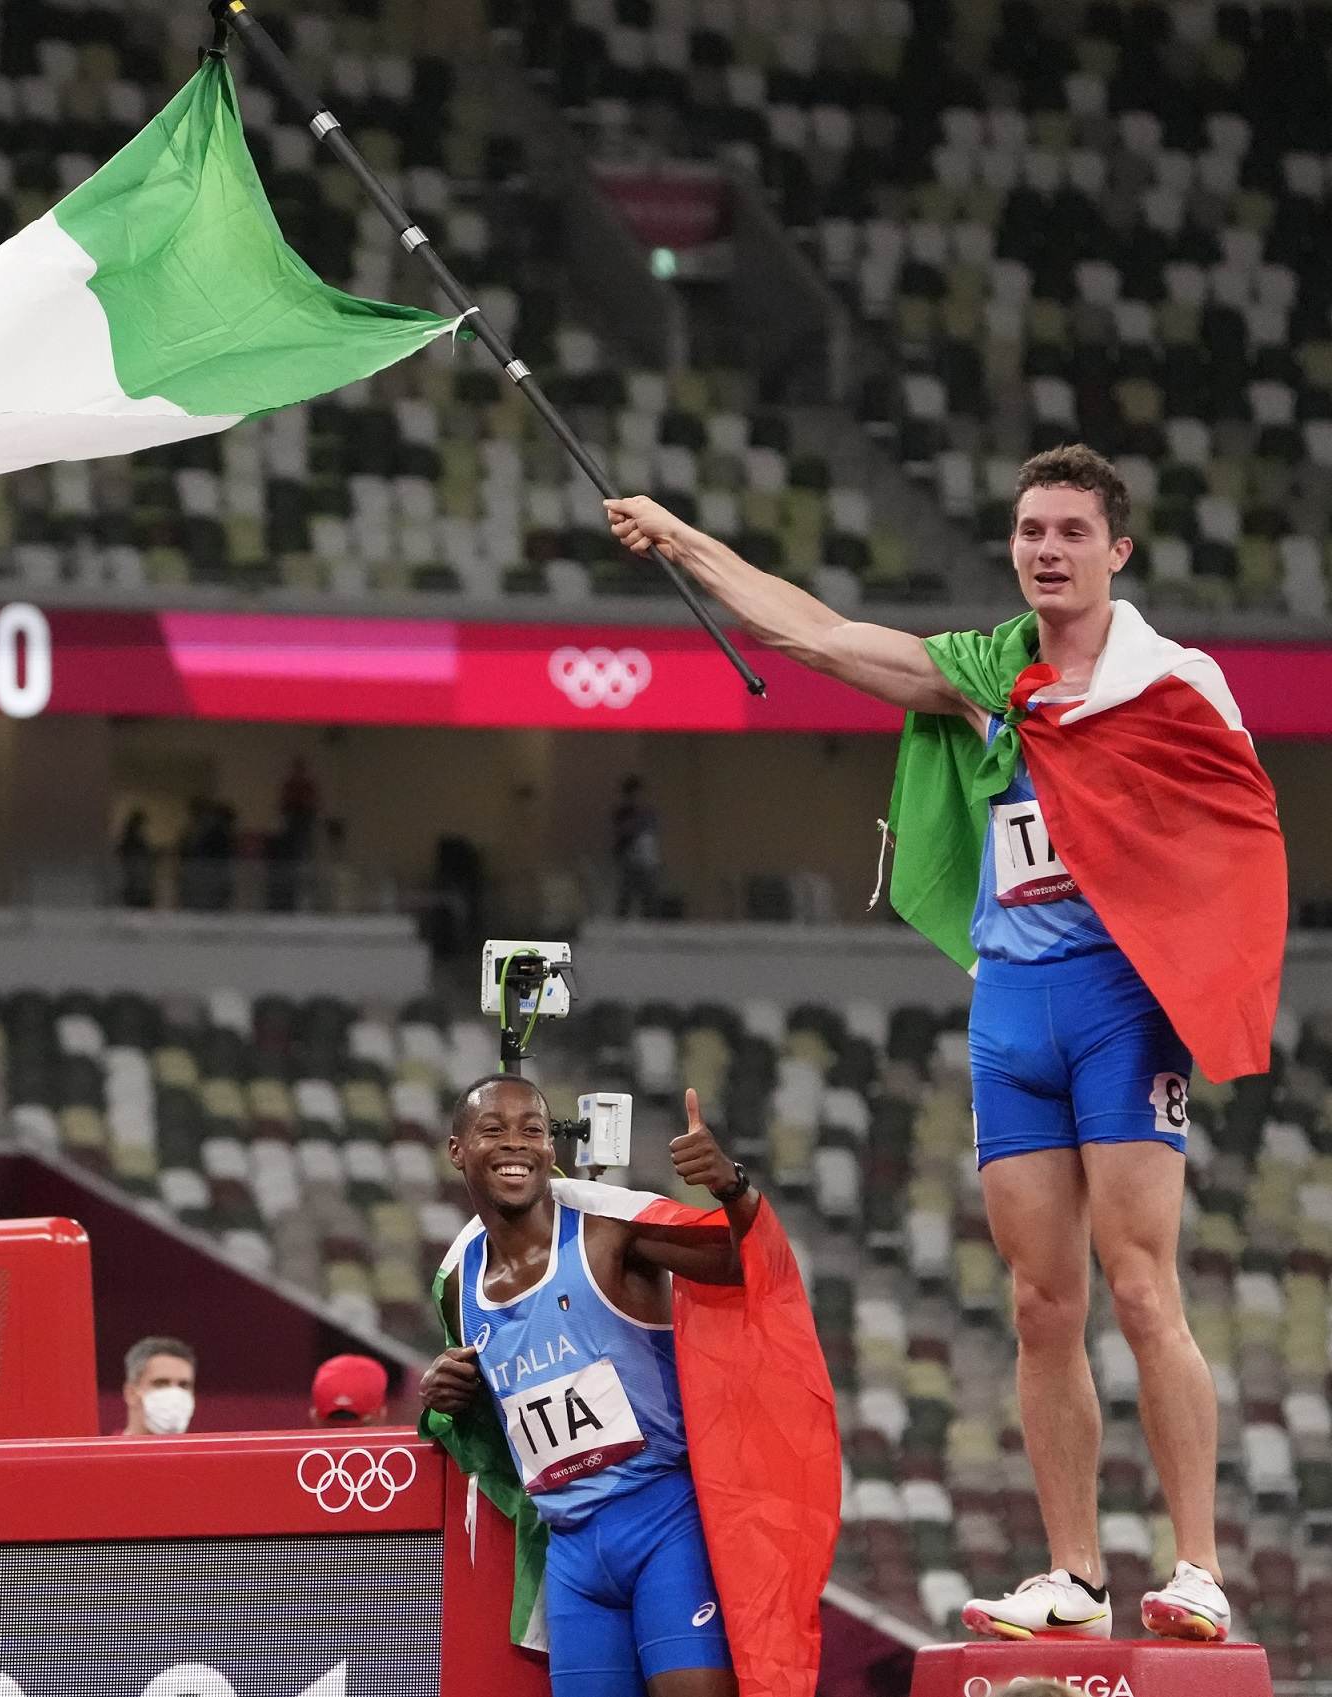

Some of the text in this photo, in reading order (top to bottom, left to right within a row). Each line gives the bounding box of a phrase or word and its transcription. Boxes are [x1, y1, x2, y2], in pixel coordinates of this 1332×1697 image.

[1166, 1078, 1185, 1127] 8
[488, 1333, 578, 1393] ITALIA
[518, 1386, 604, 1455] ITA
